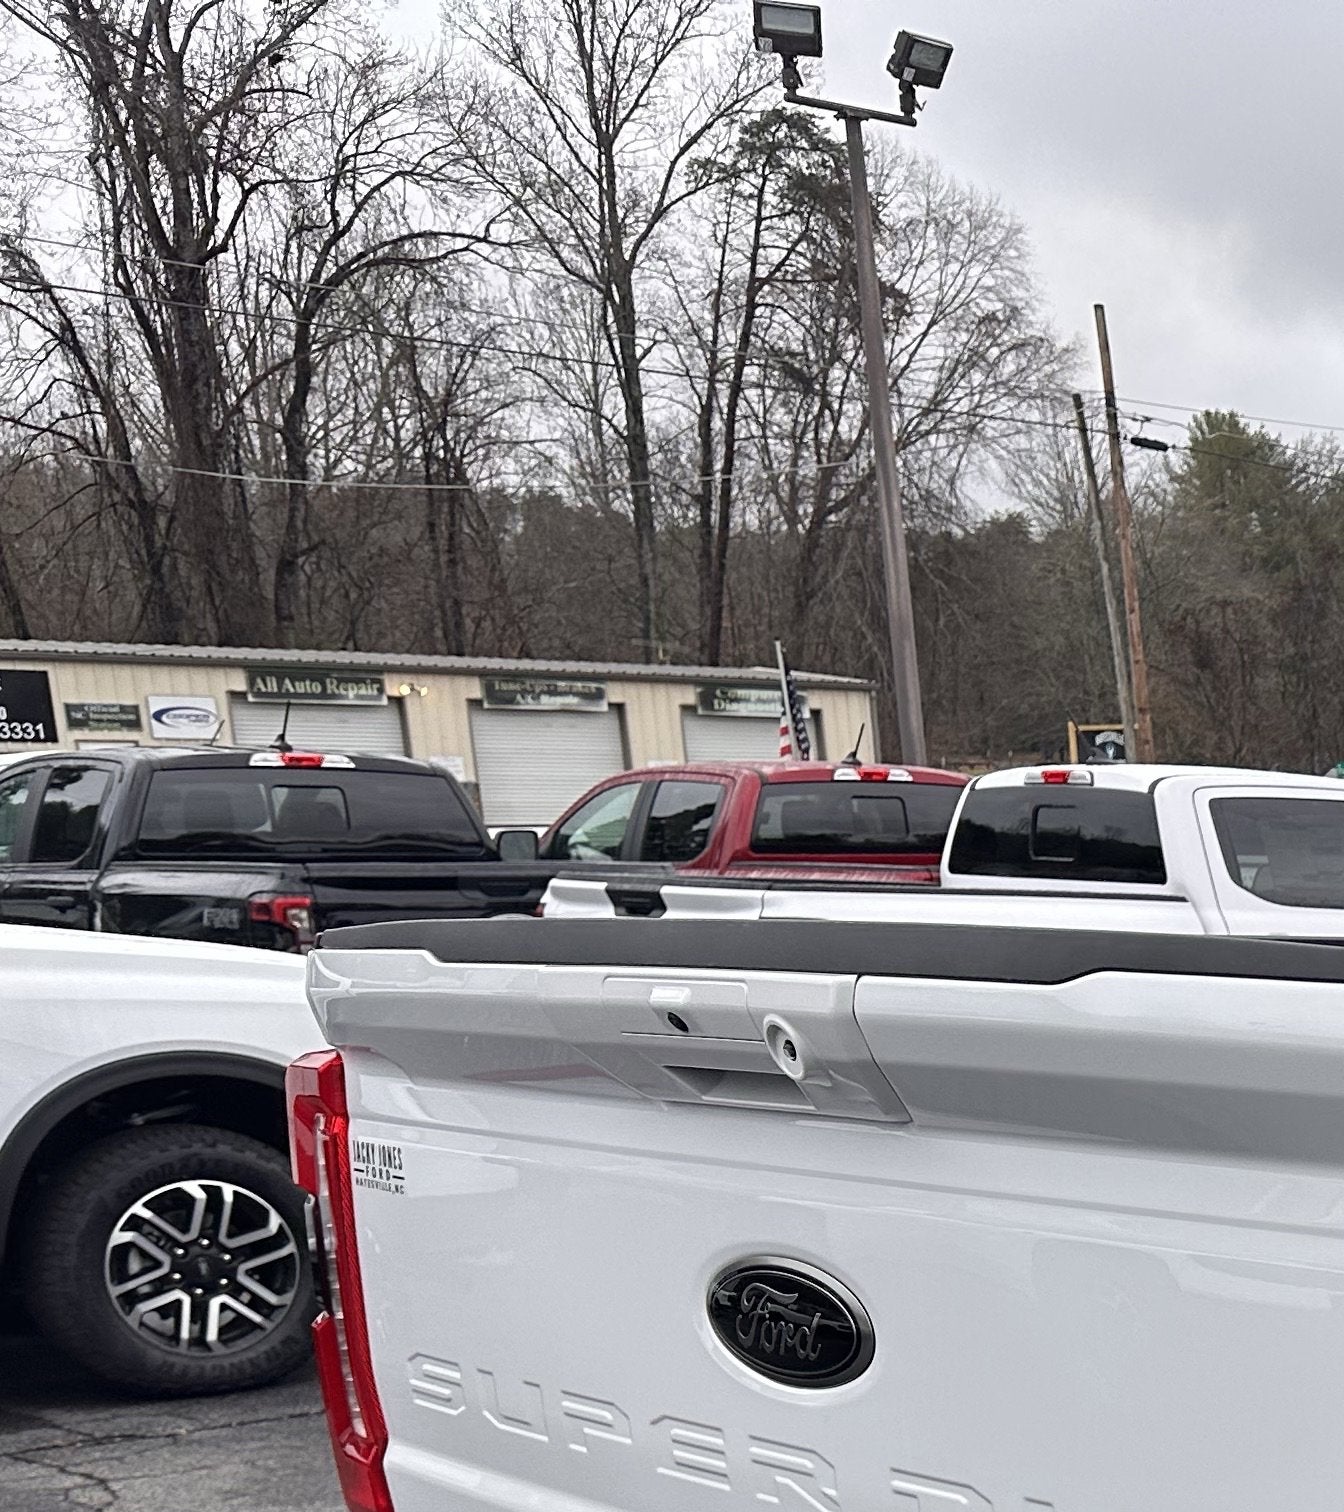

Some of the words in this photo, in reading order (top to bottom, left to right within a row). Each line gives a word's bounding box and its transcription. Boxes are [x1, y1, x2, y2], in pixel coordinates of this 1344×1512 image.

[252, 675, 278, 693] All
[281, 676, 323, 694] Auto
[325, 677, 381, 699] Repair
[352, 1139, 376, 1166] JACKY
[378, 1143, 403, 1171] JONES
[365, 1165, 391, 1181] FORD
[735, 1281, 823, 1362] Ford
